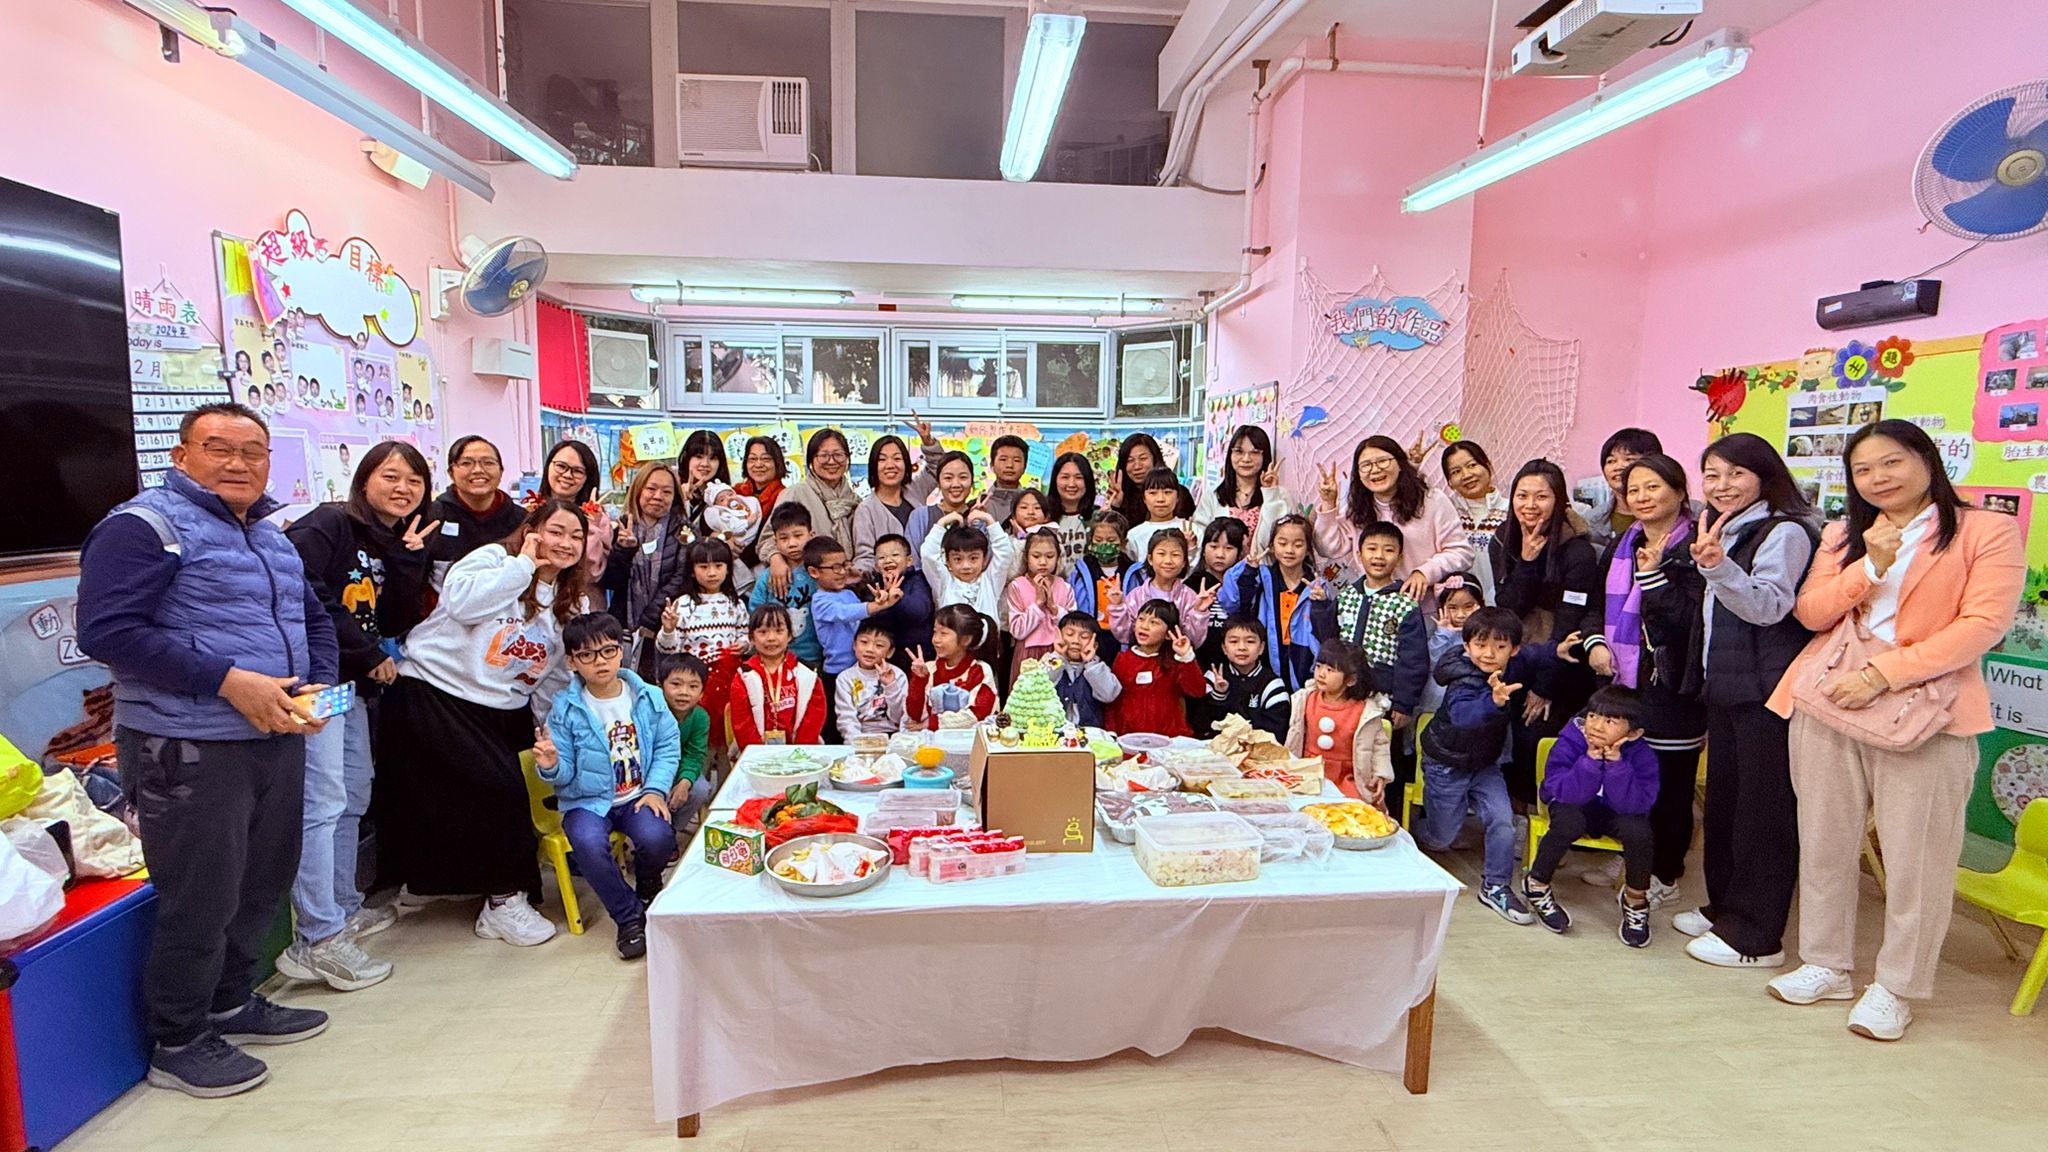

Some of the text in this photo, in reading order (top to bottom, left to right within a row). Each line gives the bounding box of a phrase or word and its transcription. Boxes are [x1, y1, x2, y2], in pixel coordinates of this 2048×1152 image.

[261, 229, 314, 268] 超級
[134, 288, 199, 324] 晴雨表
[1331, 307, 1444, 342] 我們的作品
[153, 339, 162, 349] is
[144, 397, 151, 407] 2
[160, 398, 166, 407] 3
[175, 399, 181, 407] 4
[190, 397, 195, 405] 5
[147, 417, 153, 426] 9
[162, 417, 172, 426] 10
[150, 437, 160, 445] 16
[165, 435, 174, 445] 17
[153, 454, 164, 464] 23
[1990, 666, 2043, 691] What
[2007, 706, 2023, 724] is
